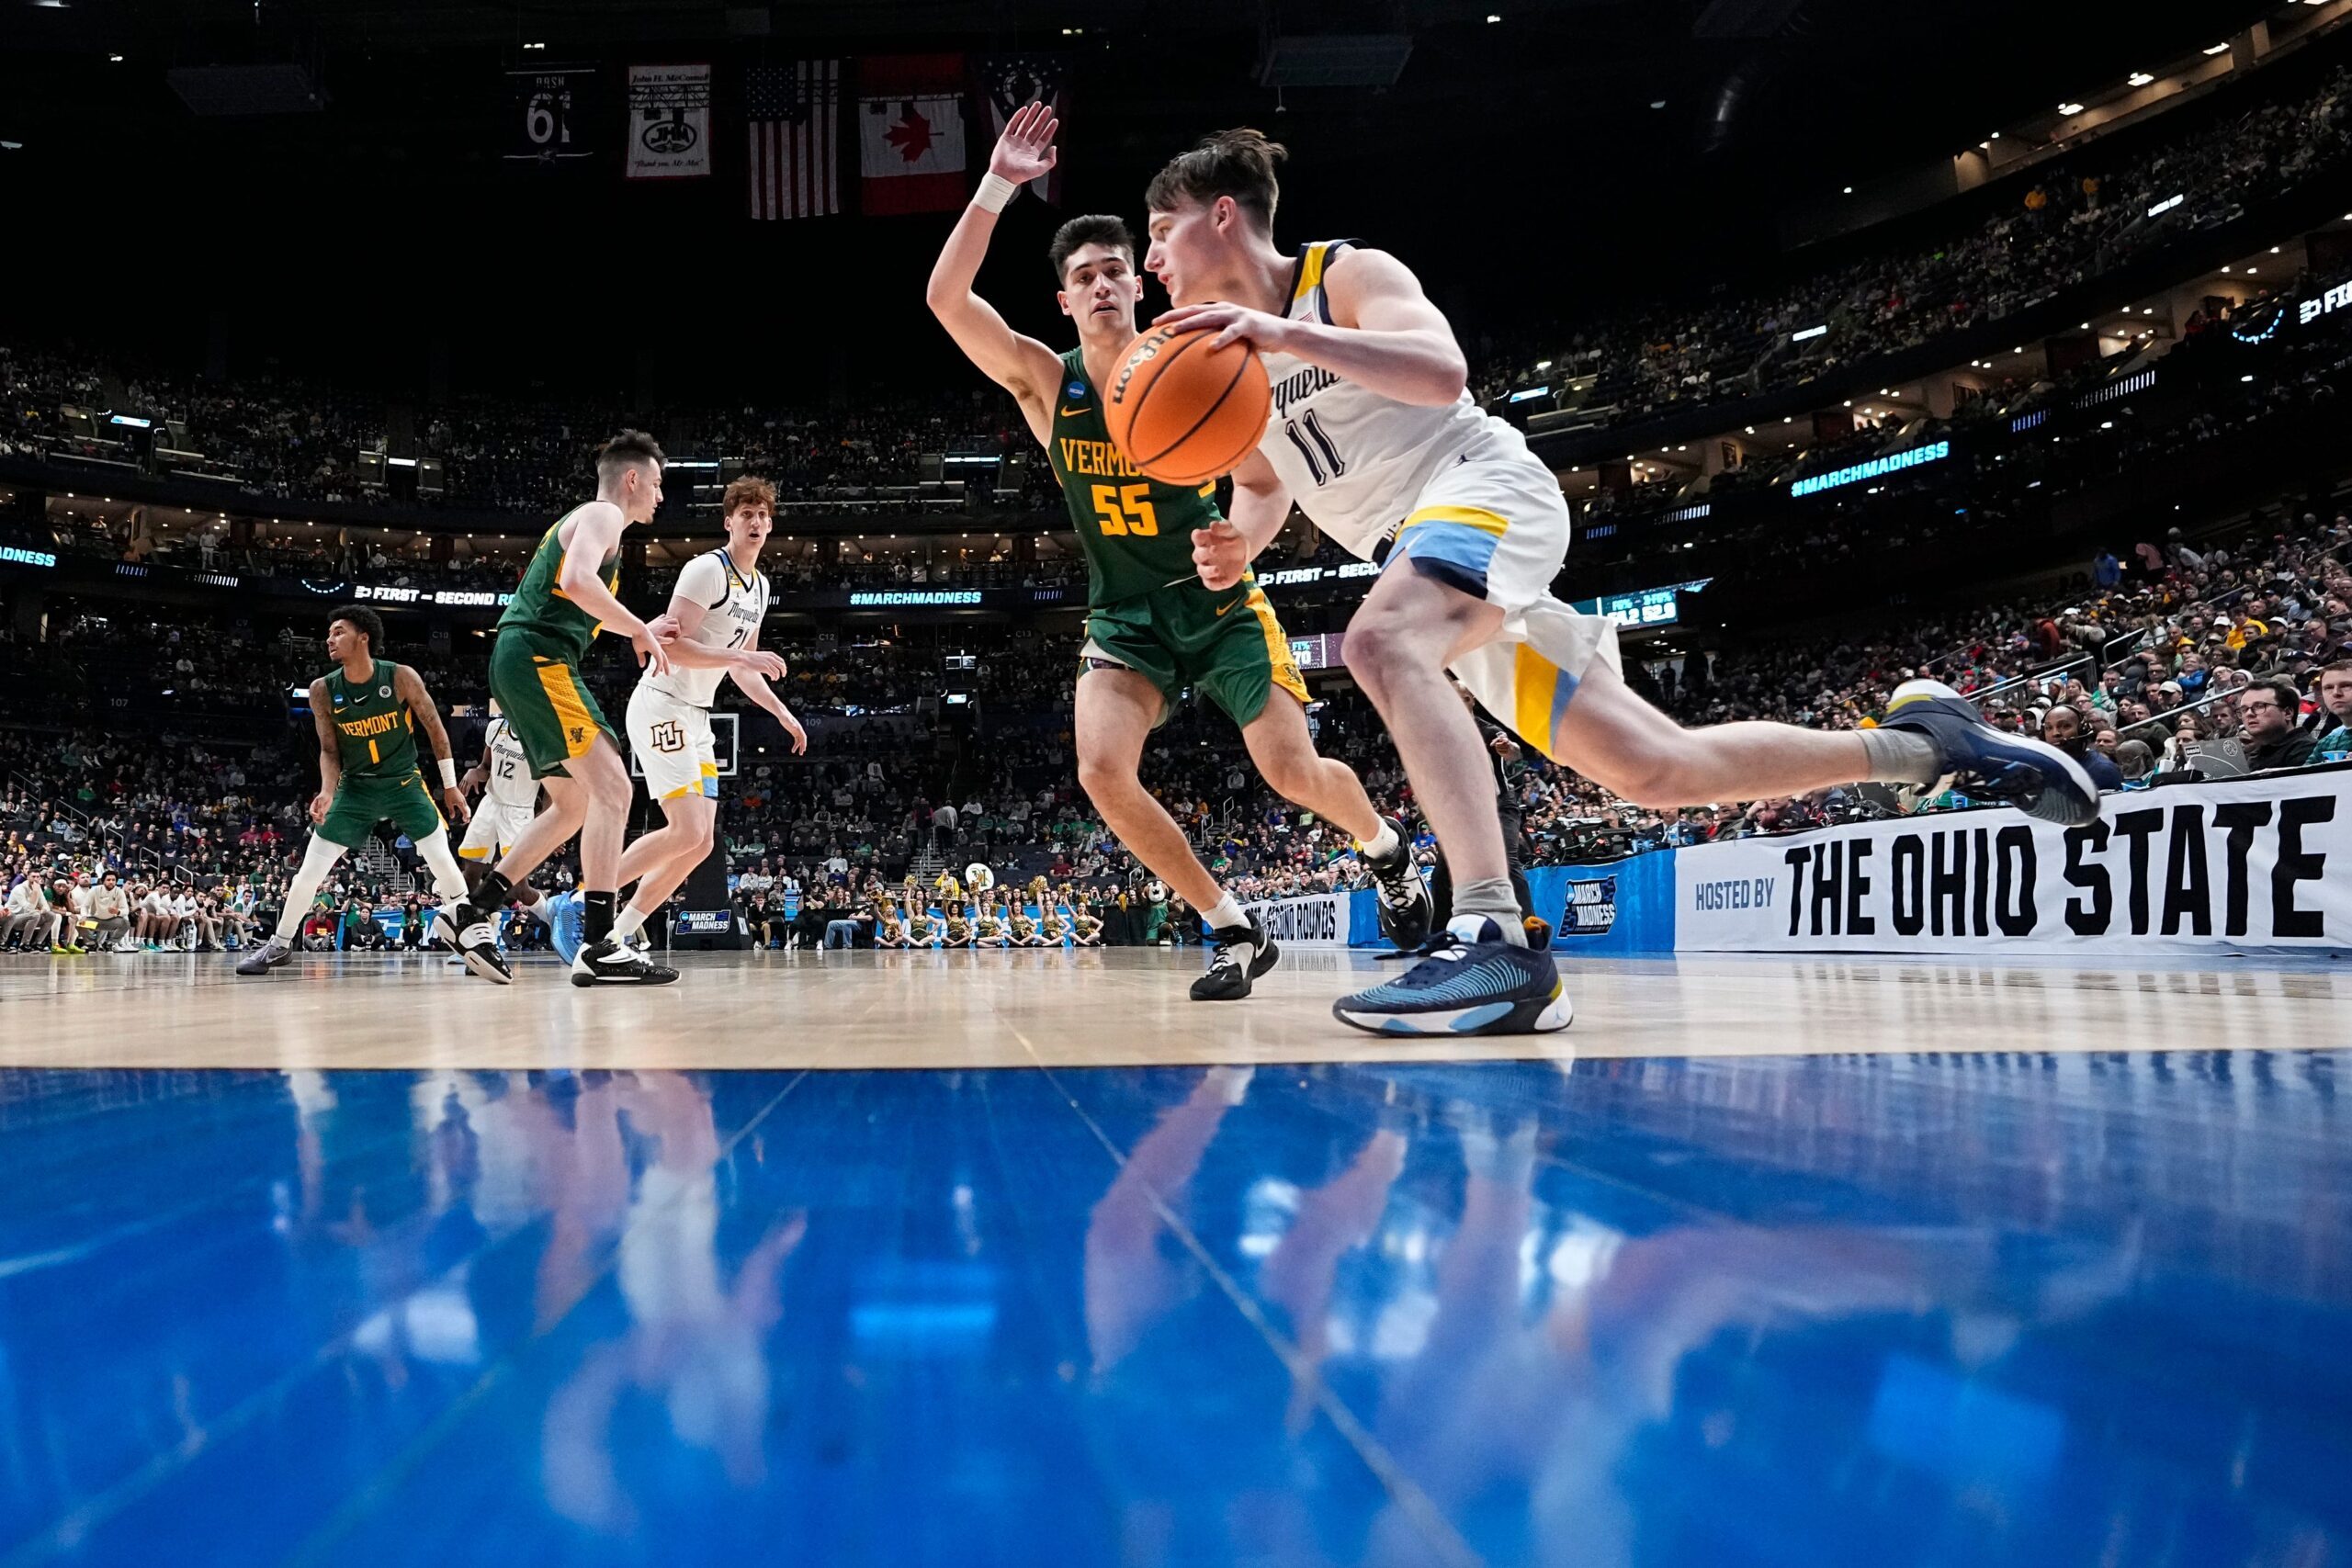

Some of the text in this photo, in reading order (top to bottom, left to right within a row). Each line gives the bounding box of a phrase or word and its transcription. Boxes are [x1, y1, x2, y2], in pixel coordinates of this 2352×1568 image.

[1285, 408, 1346, 487] 11
[1791, 440, 1950, 498] #MARCHMADNESS
[1091, 483, 1159, 536] 55
[0, 546, 56, 568] DNESS
[1275, 567, 1323, 584] FIRST
[1338, 562, 1383, 579] SECO
[373, 586, 420, 602] FIRST
[435, 591, 495, 605] SECOND
[850, 591, 982, 605] #MARCHMADNESS
[819, 633, 835, 641] C12
[110, 697, 129, 707] 107
[337, 710, 398, 738] VERMONT
[368, 739, 380, 765] 1
[497, 759, 515, 781] 12
[1784, 795, 2336, 938] THE OHIO STATE
[1571, 883, 1602, 905] MARCH
[1695, 877, 1775, 911] HOSTED BY
[688, 912, 717, 922] MARCH
[691, 921, 729, 931] MADNESS
[1296, 900, 1336, 941] ROUNDS
[1576, 904, 1615, 927] MADNESS
